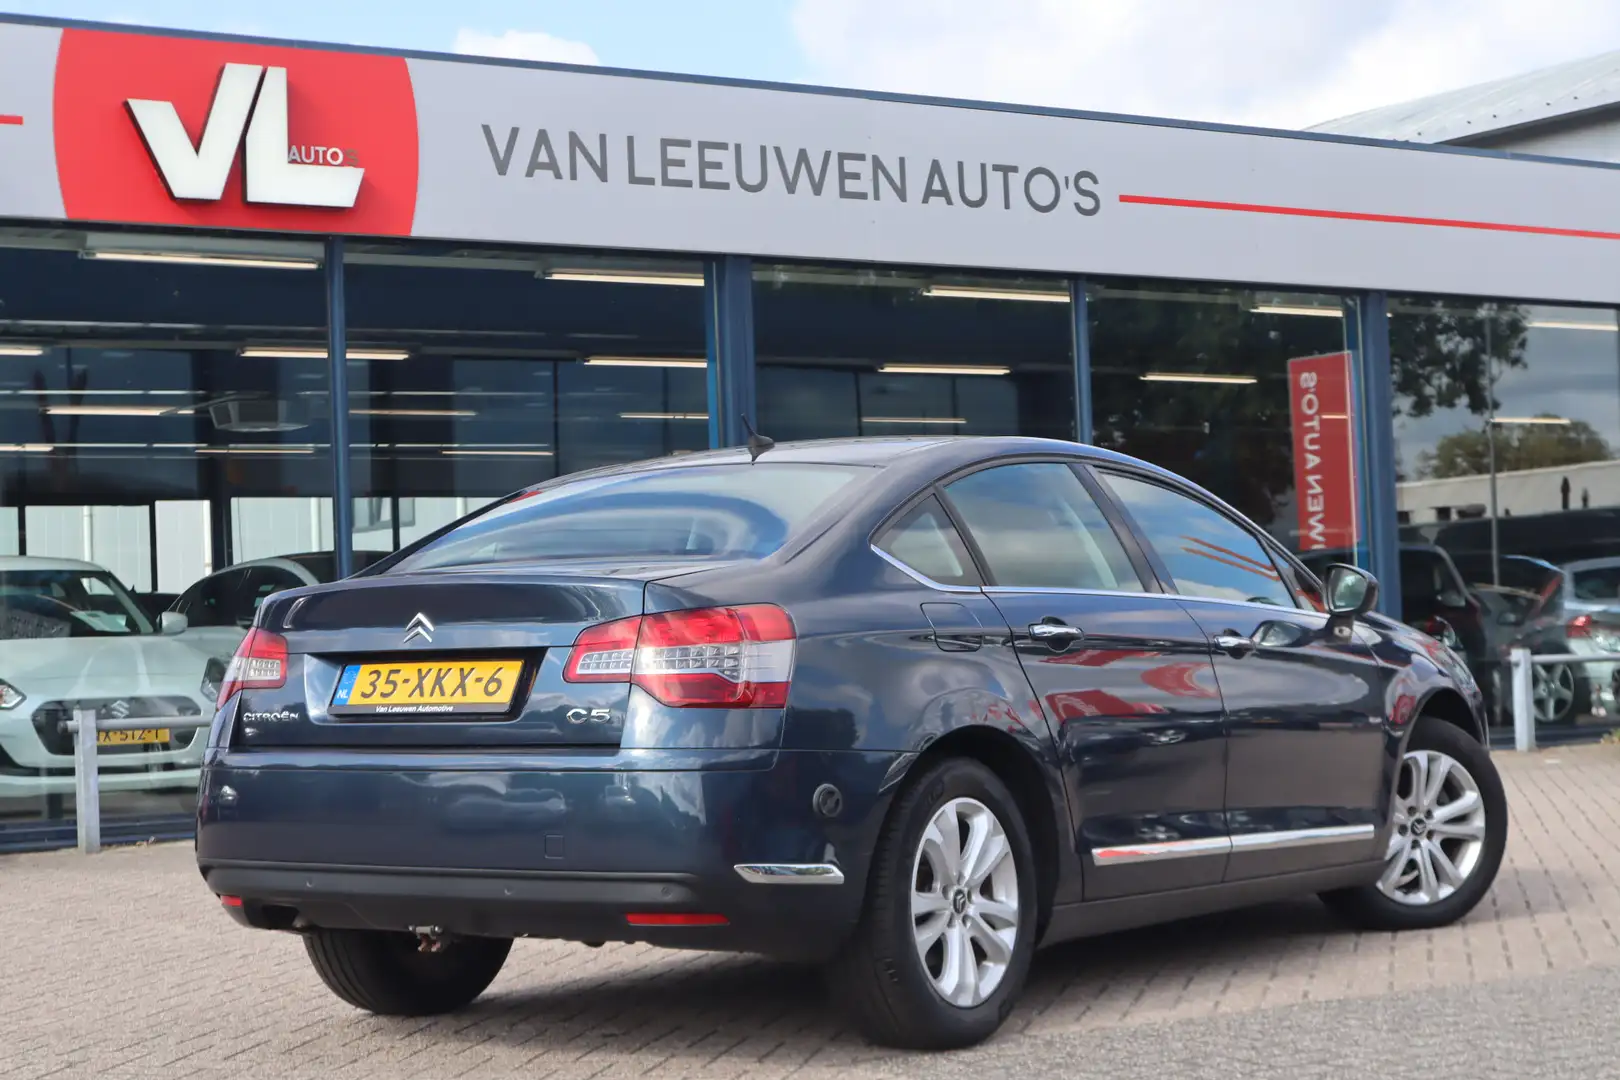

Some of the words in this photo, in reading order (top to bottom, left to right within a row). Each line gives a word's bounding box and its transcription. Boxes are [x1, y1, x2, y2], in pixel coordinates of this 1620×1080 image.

[123, 62, 365, 207] VL
[481, 123, 609, 183] VAN
[626, 134, 908, 204] LEEUWEN
[920, 158, 1101, 217] AUTO'S
[360, 666, 505, 699] 35-XKX-6
[336, 688, 349, 699] NL
[243, 710, 300, 722] CITROËN
[375, 703, 388, 713] Van
[388, 703, 417, 713] Leeuwen
[417, 702, 454, 713] Automotive
[566, 707, 611, 725] C5
